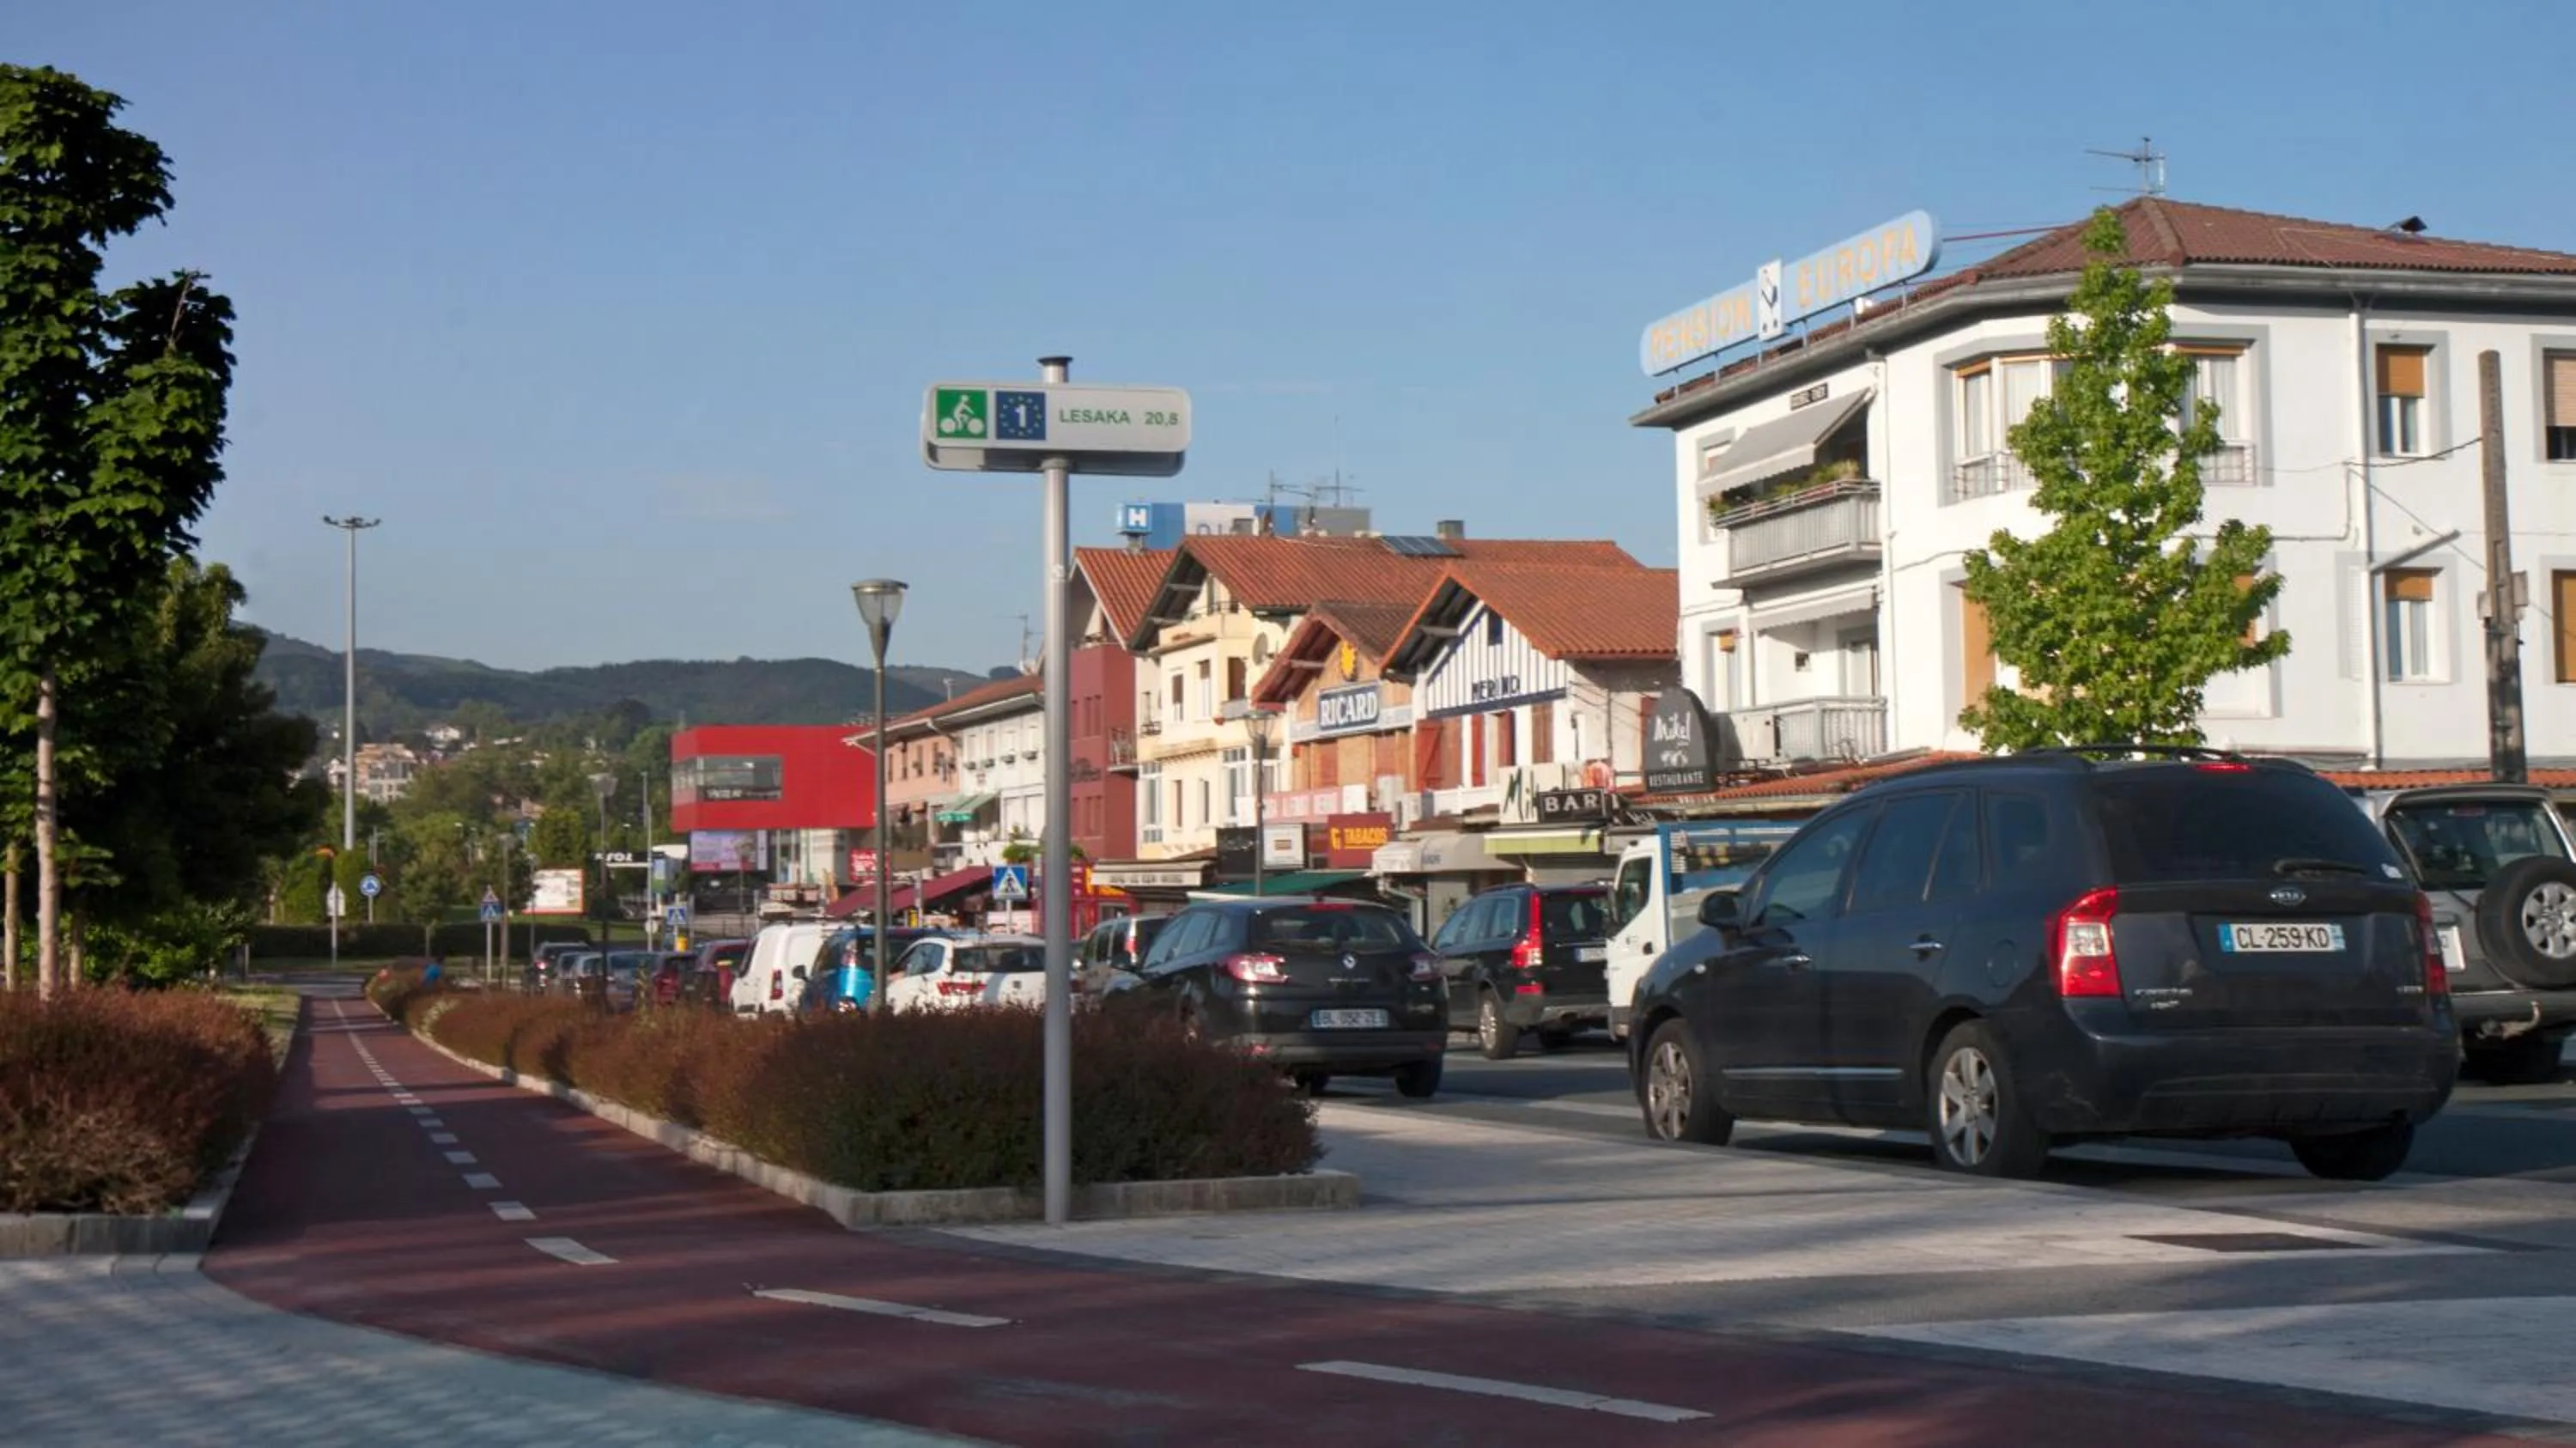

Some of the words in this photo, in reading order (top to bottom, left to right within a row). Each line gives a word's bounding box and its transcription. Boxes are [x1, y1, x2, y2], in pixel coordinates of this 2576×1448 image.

[1649, 295, 1753, 359] PENSION
[1795, 223, 1920, 309] EUROPA
[1014, 404, 1027, 428] 1
[1059, 409, 1131, 425] LESAKA
[1144, 411, 1179, 427] 20,8
[1127, 508, 1148, 526] H
[1320, 691, 1379, 727] RICARD
[1647, 770, 1704, 788] RESTAURANTE
[1544, 793, 1599, 813] BAR
[1343, 826, 1388, 844] TABACOS
[2235, 927, 2330, 950] CL-259-KD
